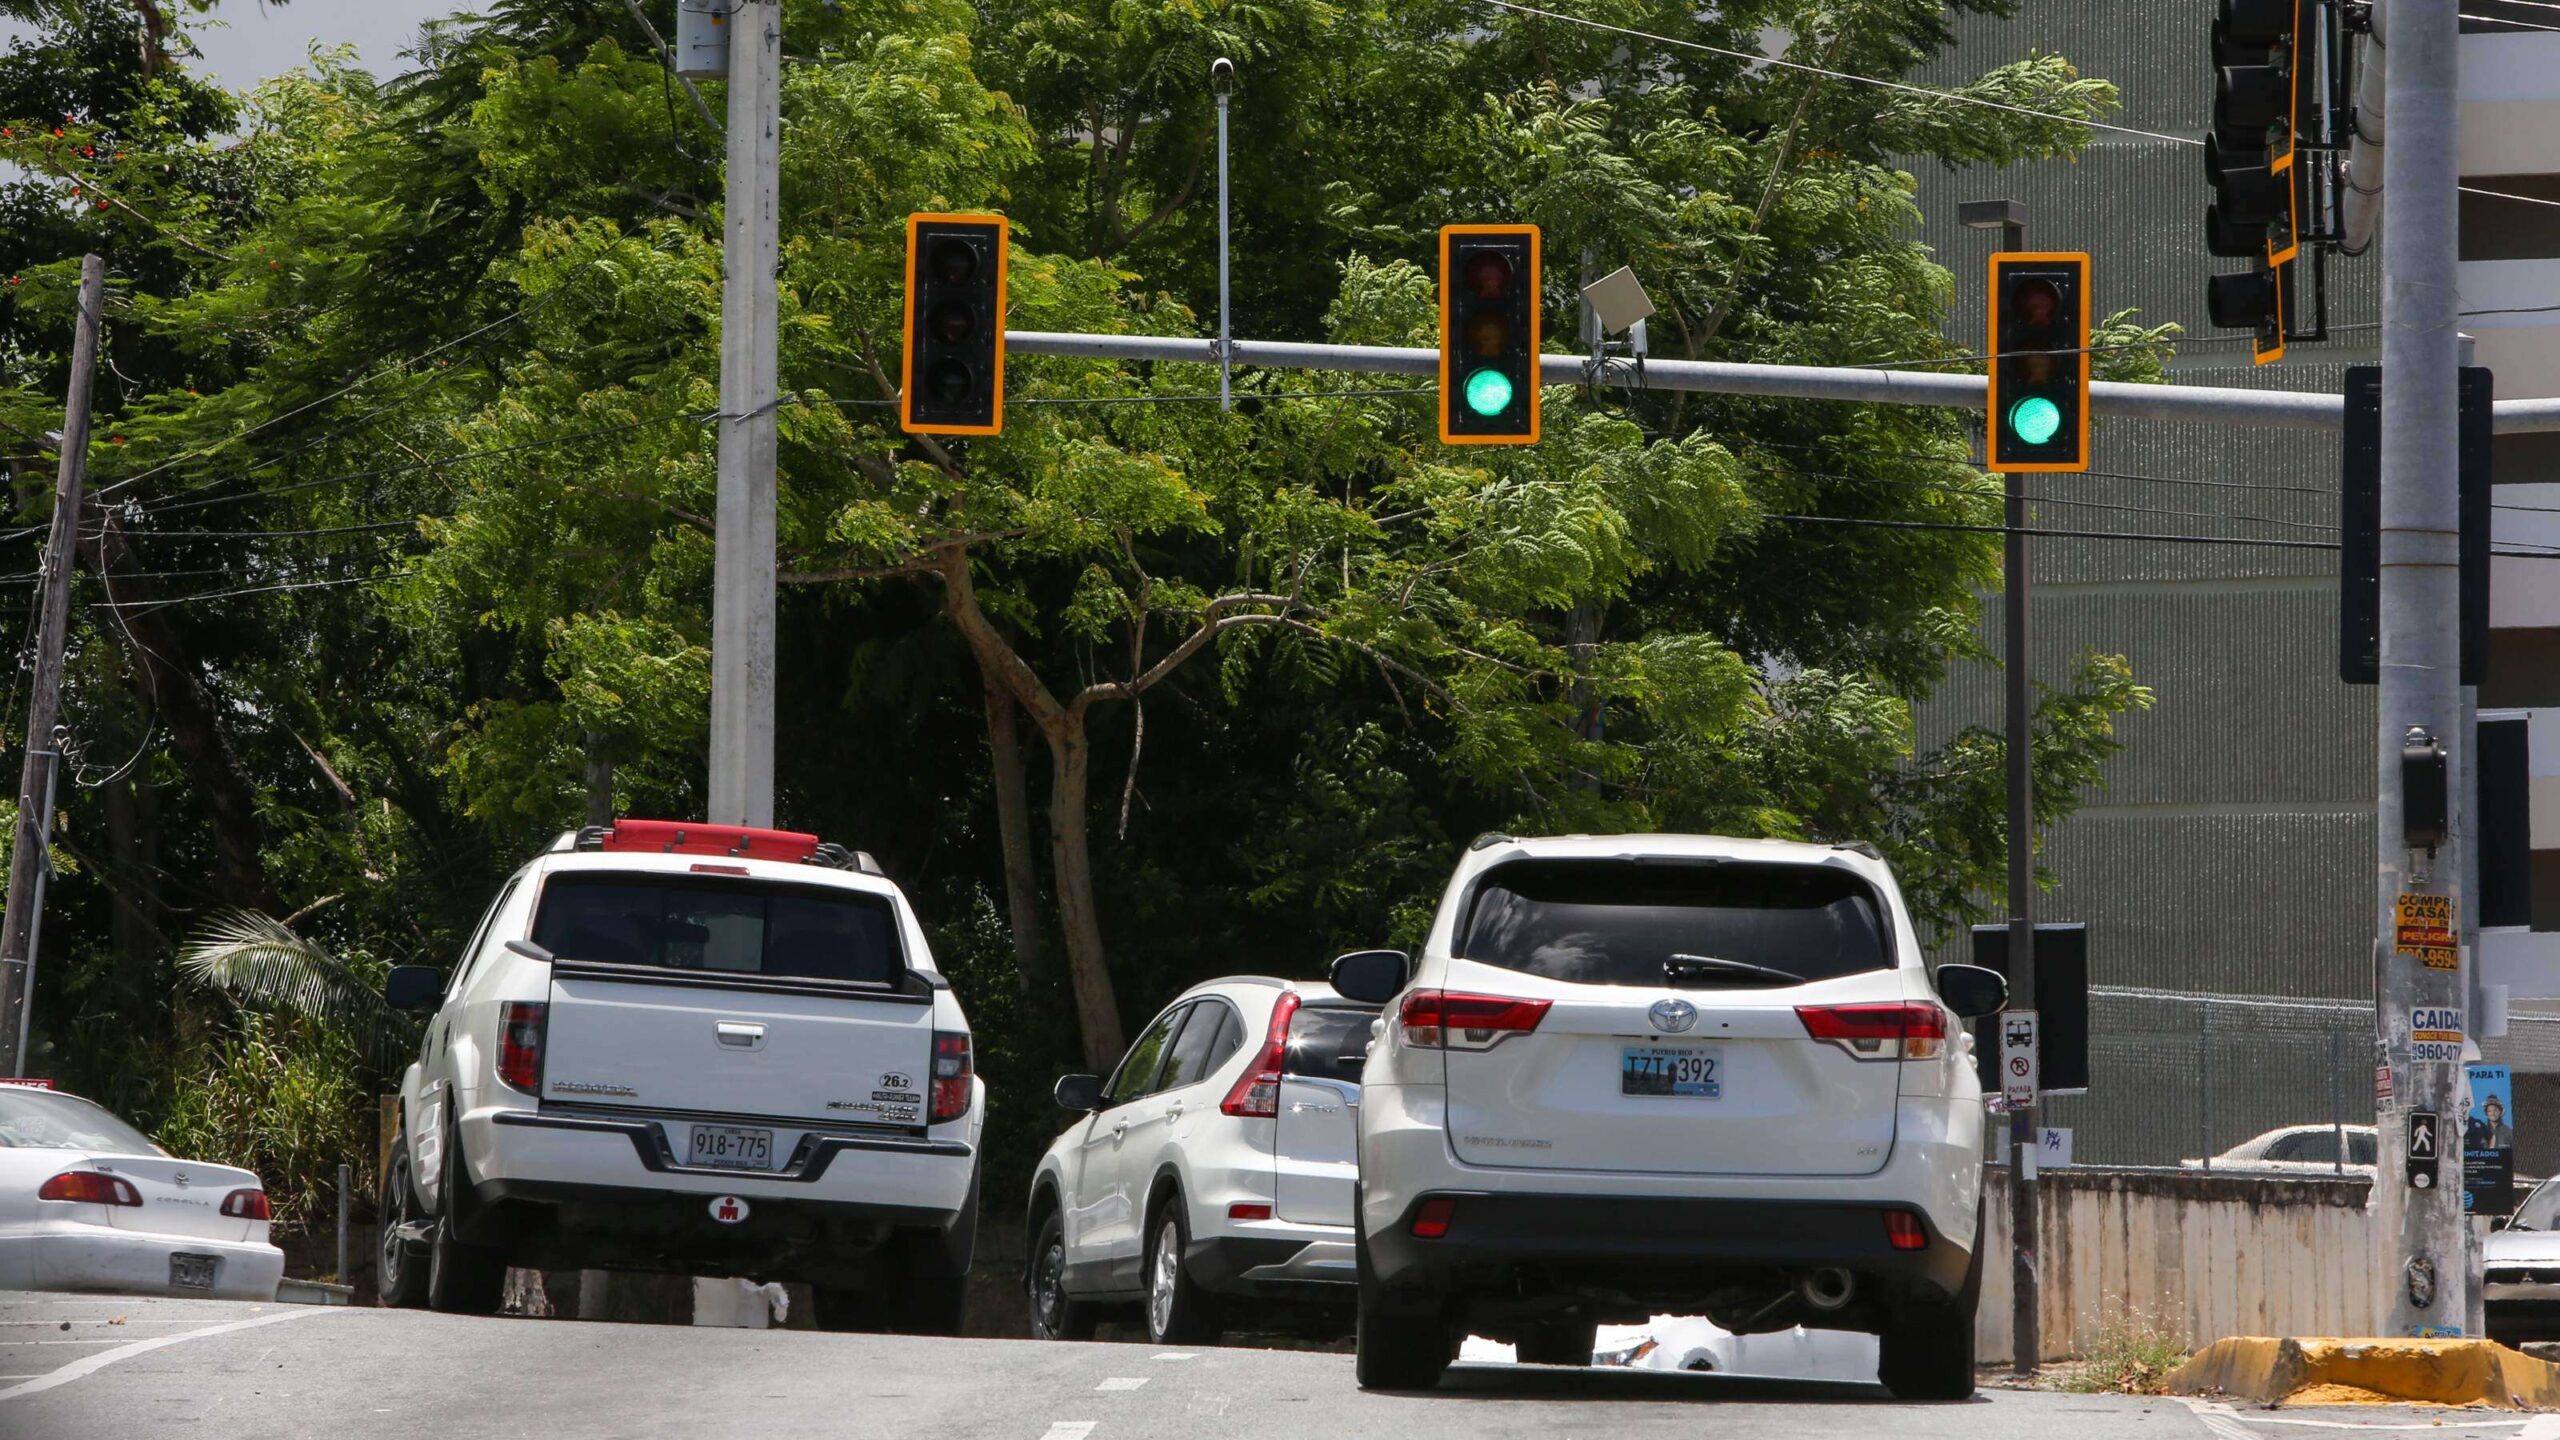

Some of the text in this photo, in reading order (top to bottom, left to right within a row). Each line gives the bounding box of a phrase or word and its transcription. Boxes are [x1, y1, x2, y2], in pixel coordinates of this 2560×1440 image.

[2412, 1010, 2463, 1031] CAIDA
[1678, 1058, 1715, 1083] 392
[2469, 1070, 2494, 1080] PARA
[883, 1075, 909, 1088] 26.2
[696, 1133, 767, 1158] 918-775
[156, 1196, 209, 1206] COROLLA
